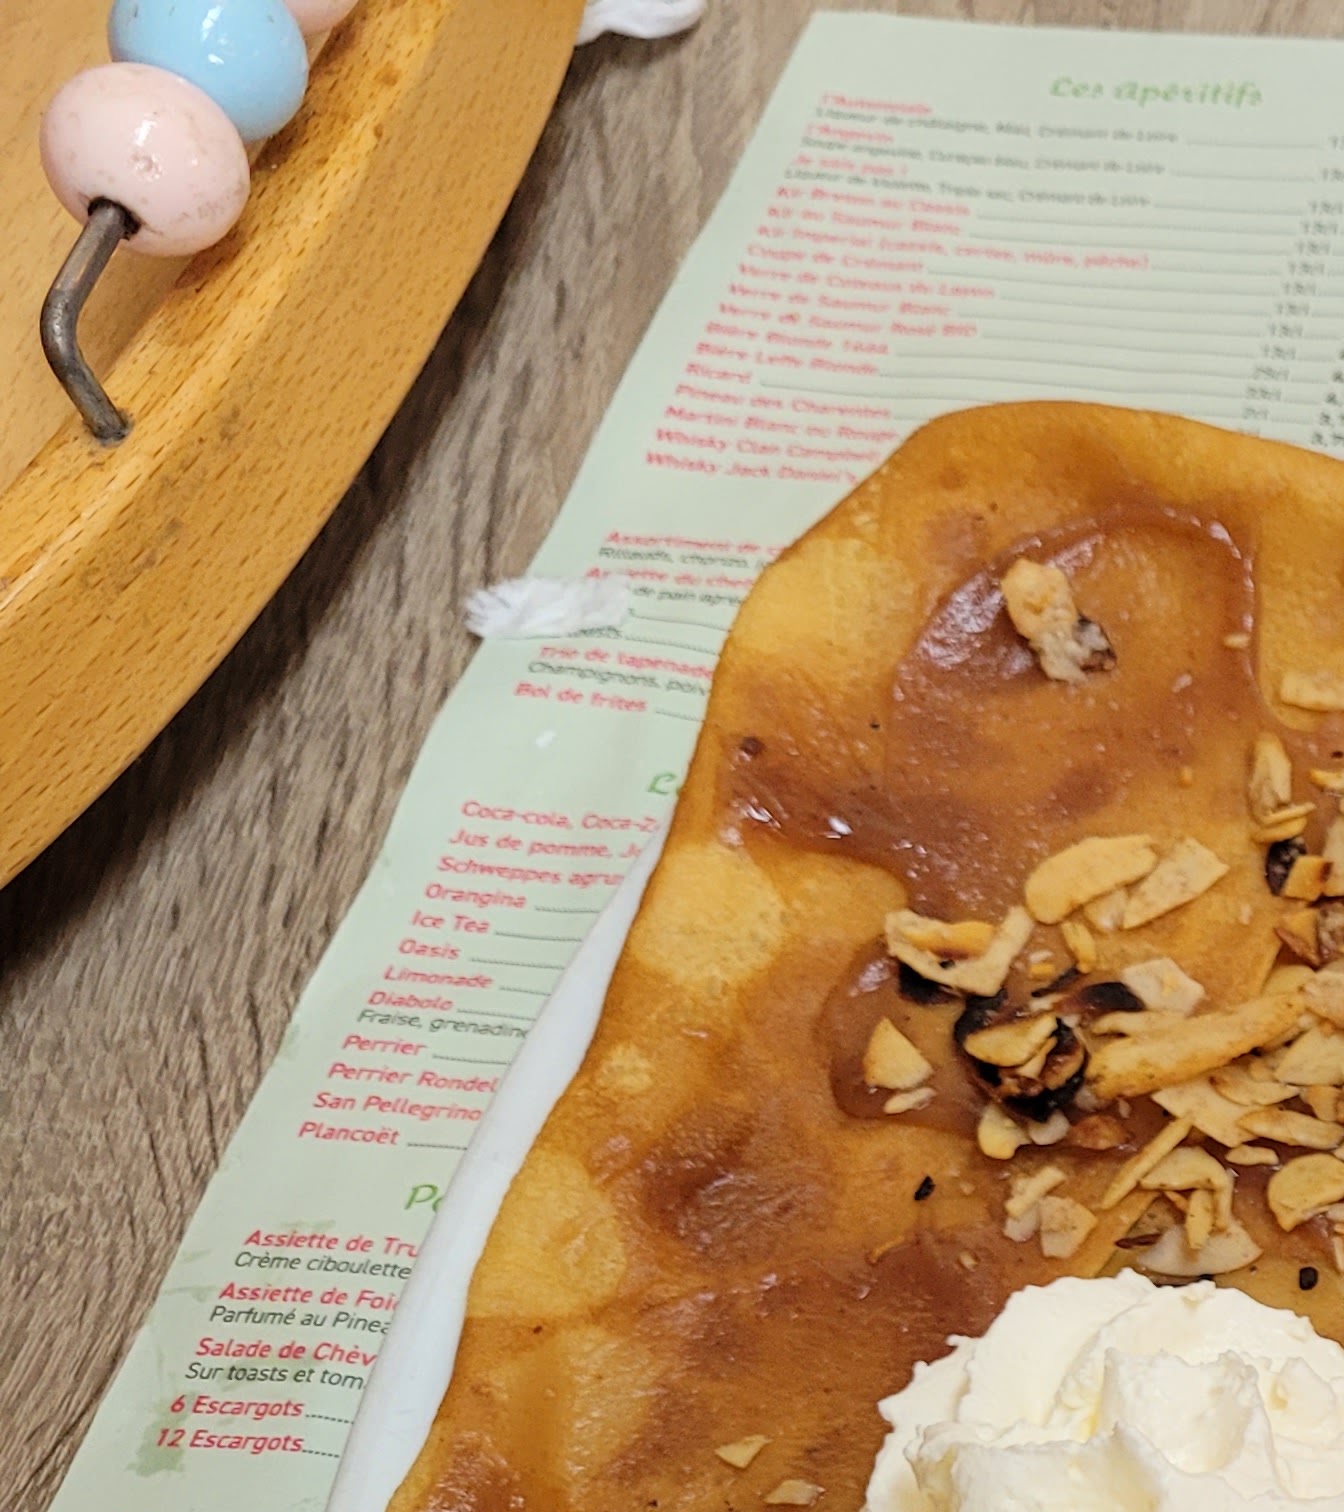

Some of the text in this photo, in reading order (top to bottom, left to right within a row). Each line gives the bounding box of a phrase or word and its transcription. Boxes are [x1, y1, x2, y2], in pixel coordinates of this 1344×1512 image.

[424, 882, 528, 908] Orangina
[411, 910, 491, 934] Ice Tea
[399, 938, 461, 960] Oasis
[383, 965, 495, 989] Limonade
[342, 1034, 427, 1056] Perrier
[328, 1062, 414, 1084] Perrier
[313, 1091, 482, 1122] San Pellegrino
[298, 1120, 402, 1146] Plancoët
[244, 1229, 374, 1253] Assiette de
[234, 1251, 413, 1280] Crème ciboulette
[219, 1282, 348, 1306] Assiette de
[209, 1305, 296, 1327] Parfumé
[194, 1337, 271, 1360] Salade
[278, 1341, 306, 1360] de
[184, 1361, 288, 1384] Sur toasts
[192, 1395, 304, 1421] Escargots
[189, 1428, 304, 1455] Escargots
